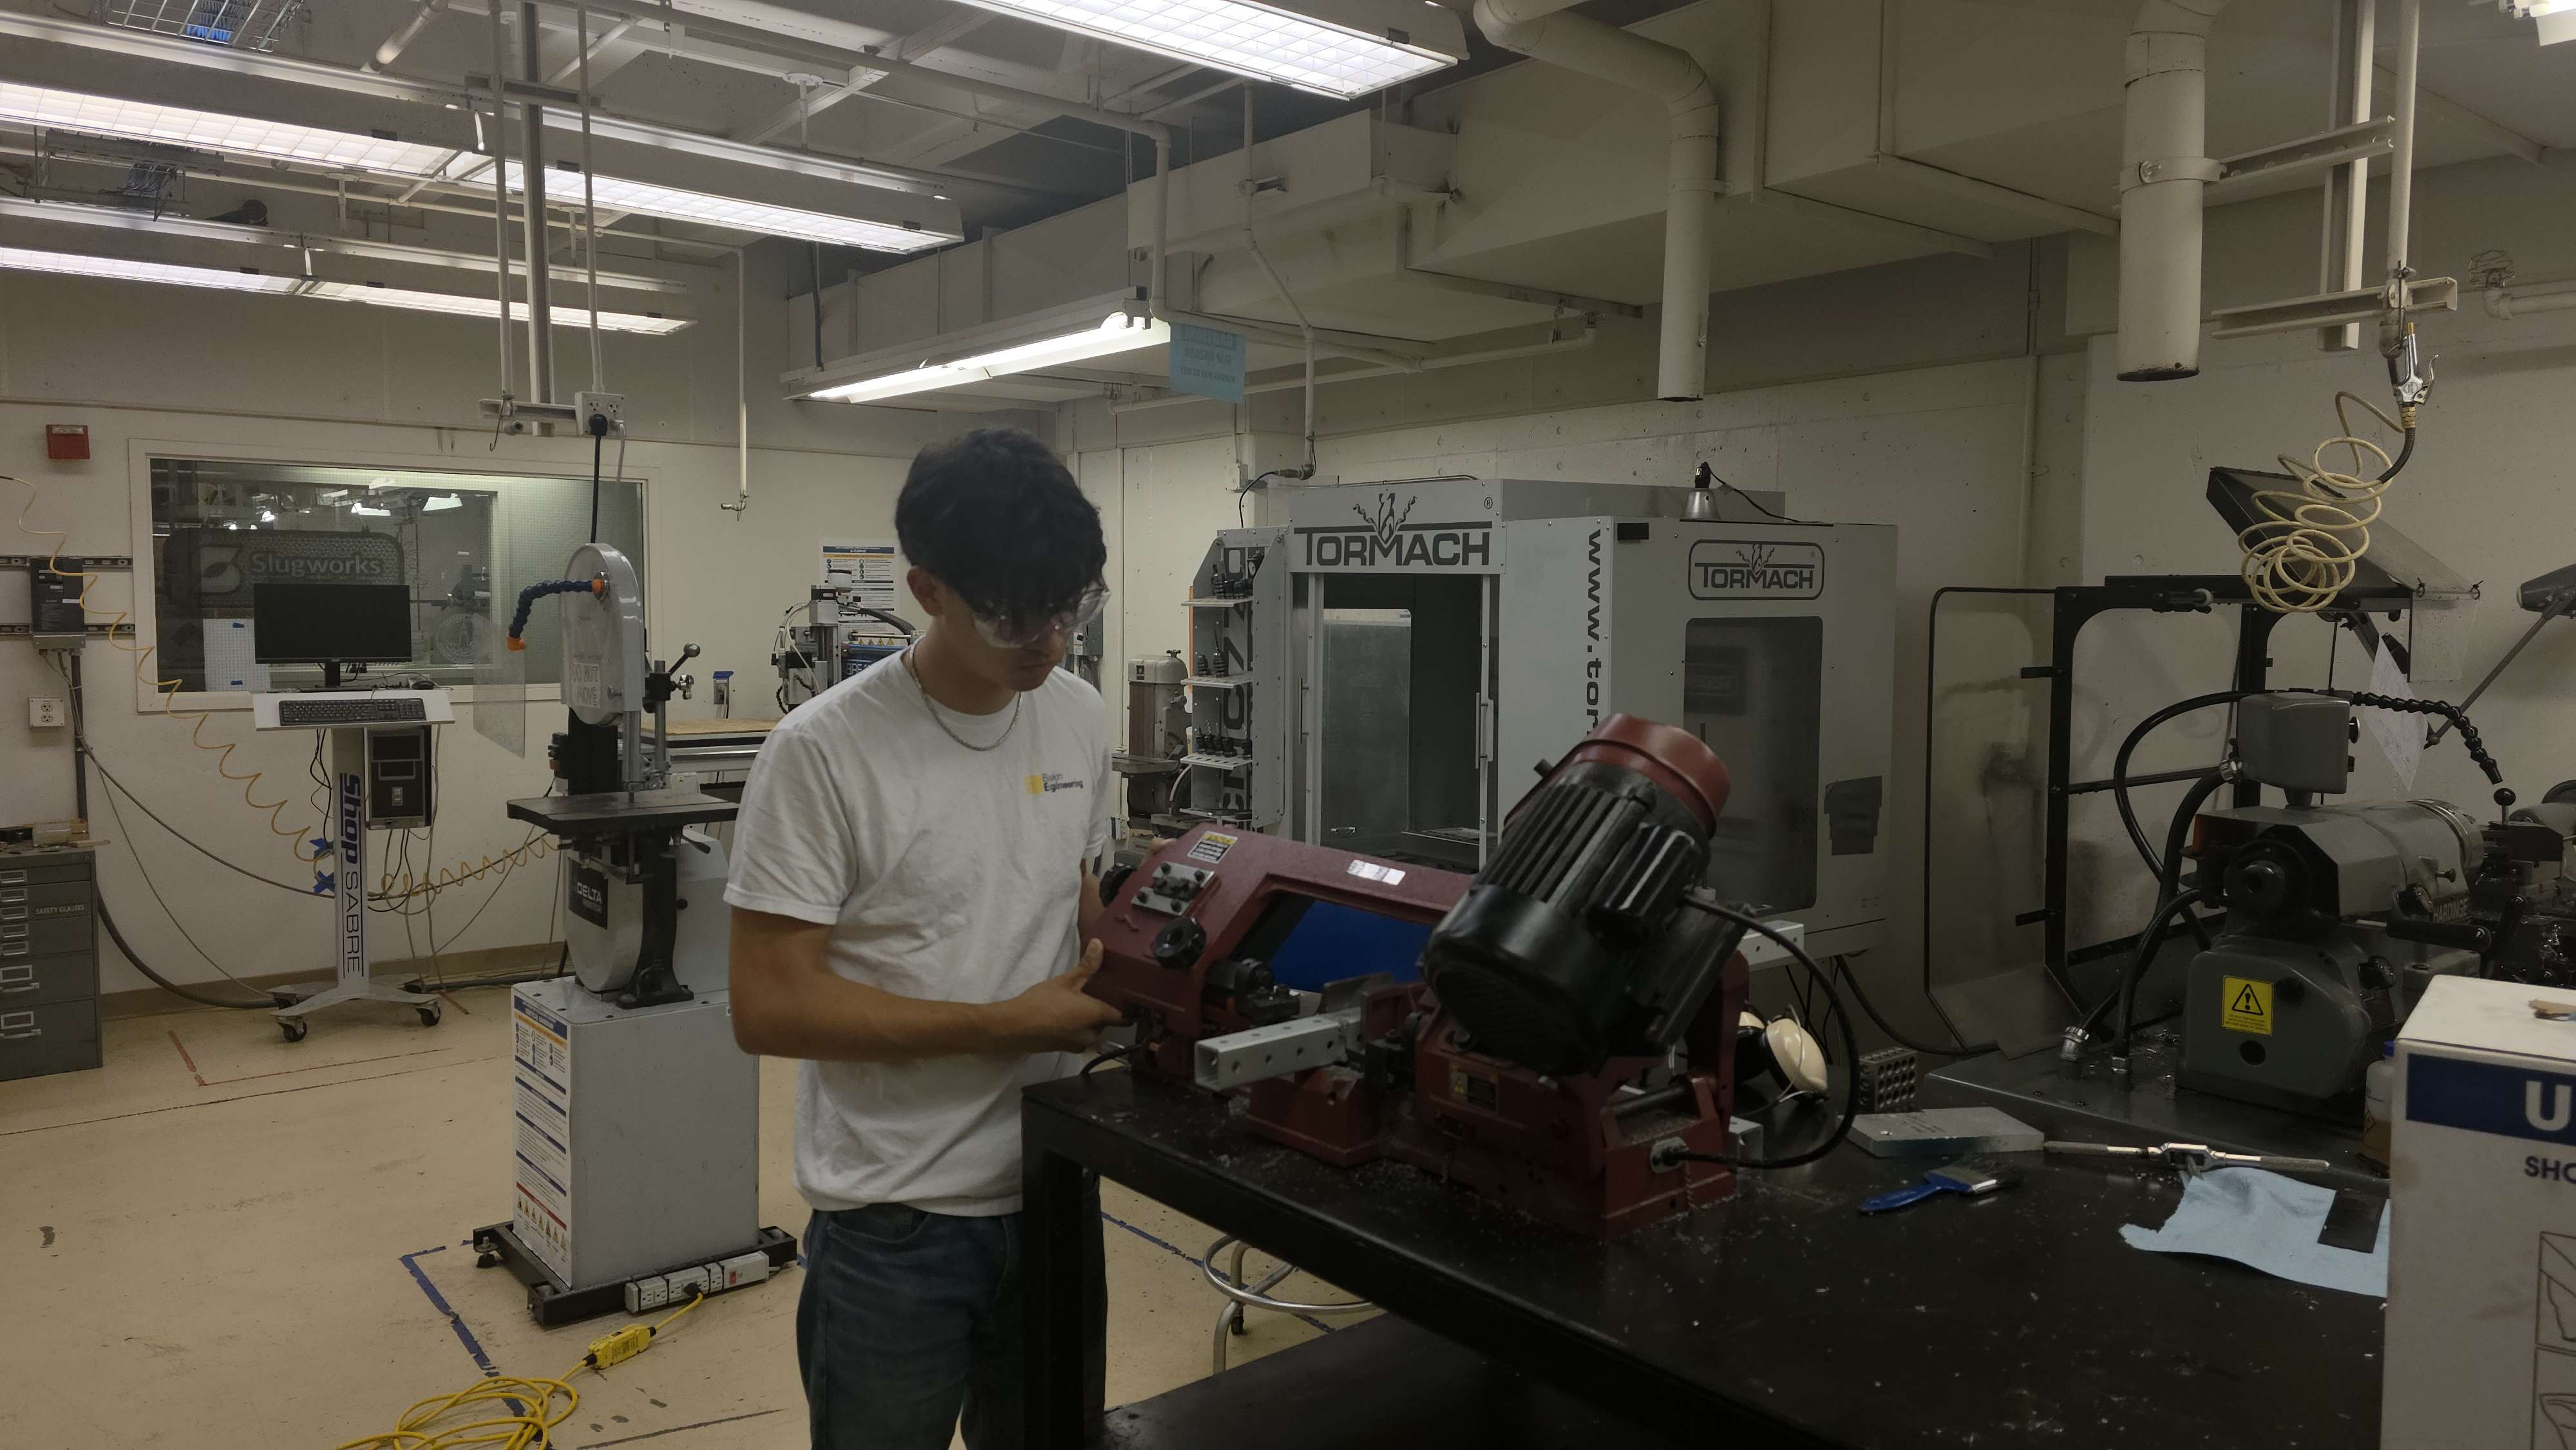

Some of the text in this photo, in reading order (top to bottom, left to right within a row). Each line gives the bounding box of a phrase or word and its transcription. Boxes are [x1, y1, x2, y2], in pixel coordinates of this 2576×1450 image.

[252, 552, 382, 578] Slugworks
[1294, 521, 1492, 566] TORMACH
[1695, 562, 1815, 589] TORMACH
[1587, 529, 1602, 736] www.tor
[577, 881, 603, 904] DELTA
[345, 871, 361, 973] SABRE
[2524, 1079, 2573, 1131] U
